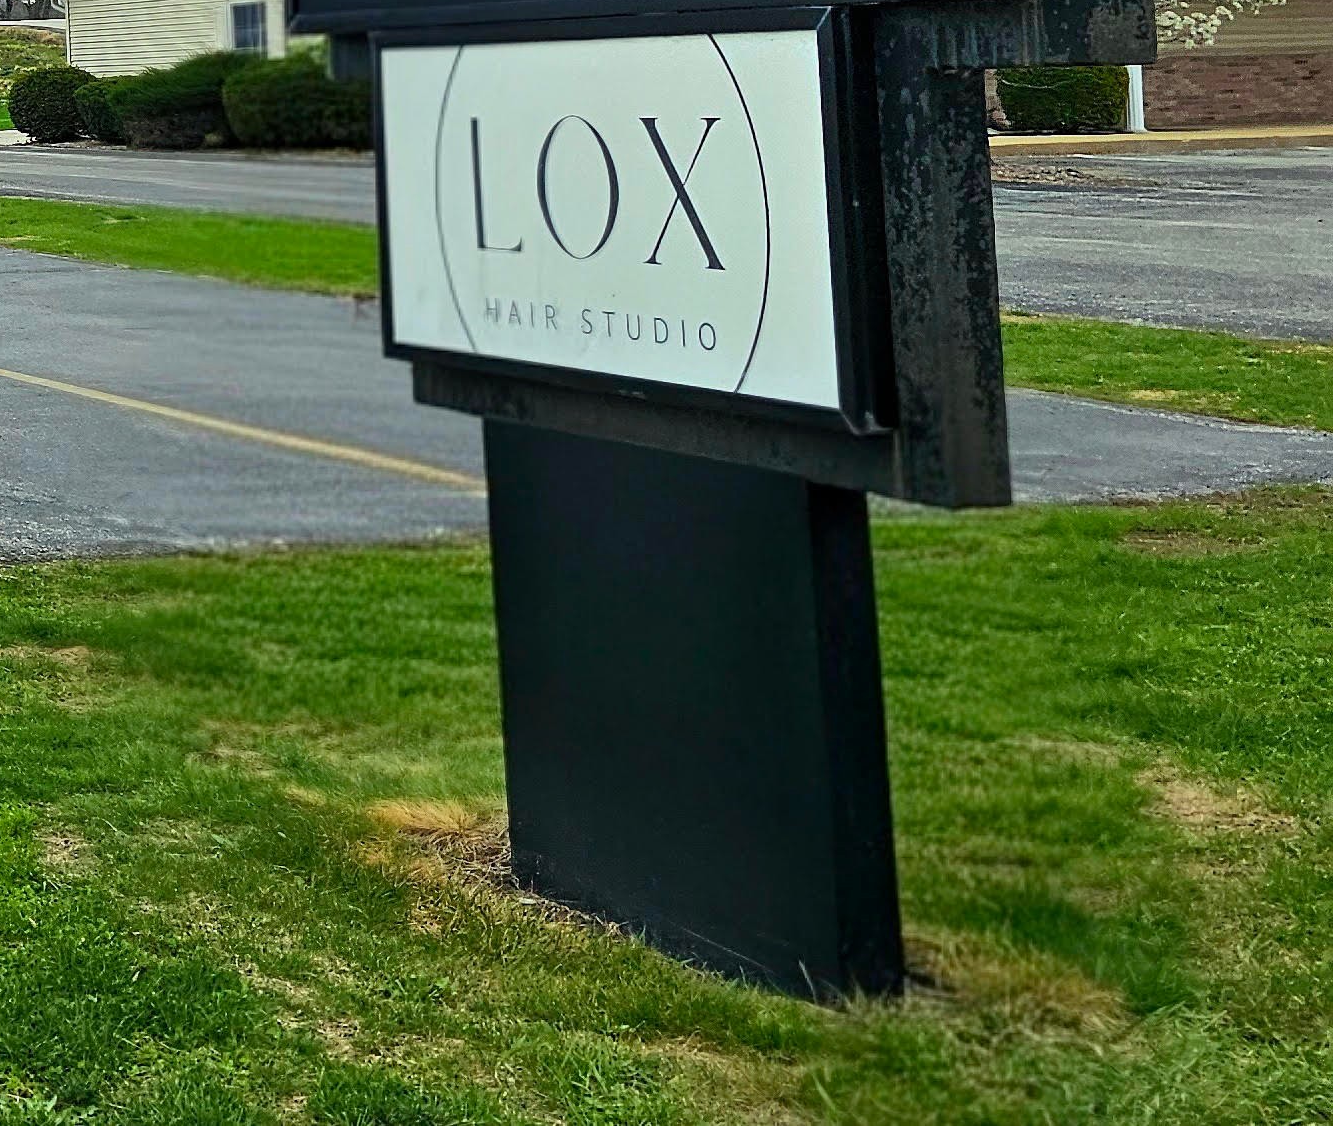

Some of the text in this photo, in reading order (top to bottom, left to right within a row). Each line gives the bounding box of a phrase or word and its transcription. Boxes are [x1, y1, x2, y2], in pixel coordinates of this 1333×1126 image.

[470, 115, 726, 271] LOX
[485, 297, 717, 351] HAIR STUDIO
